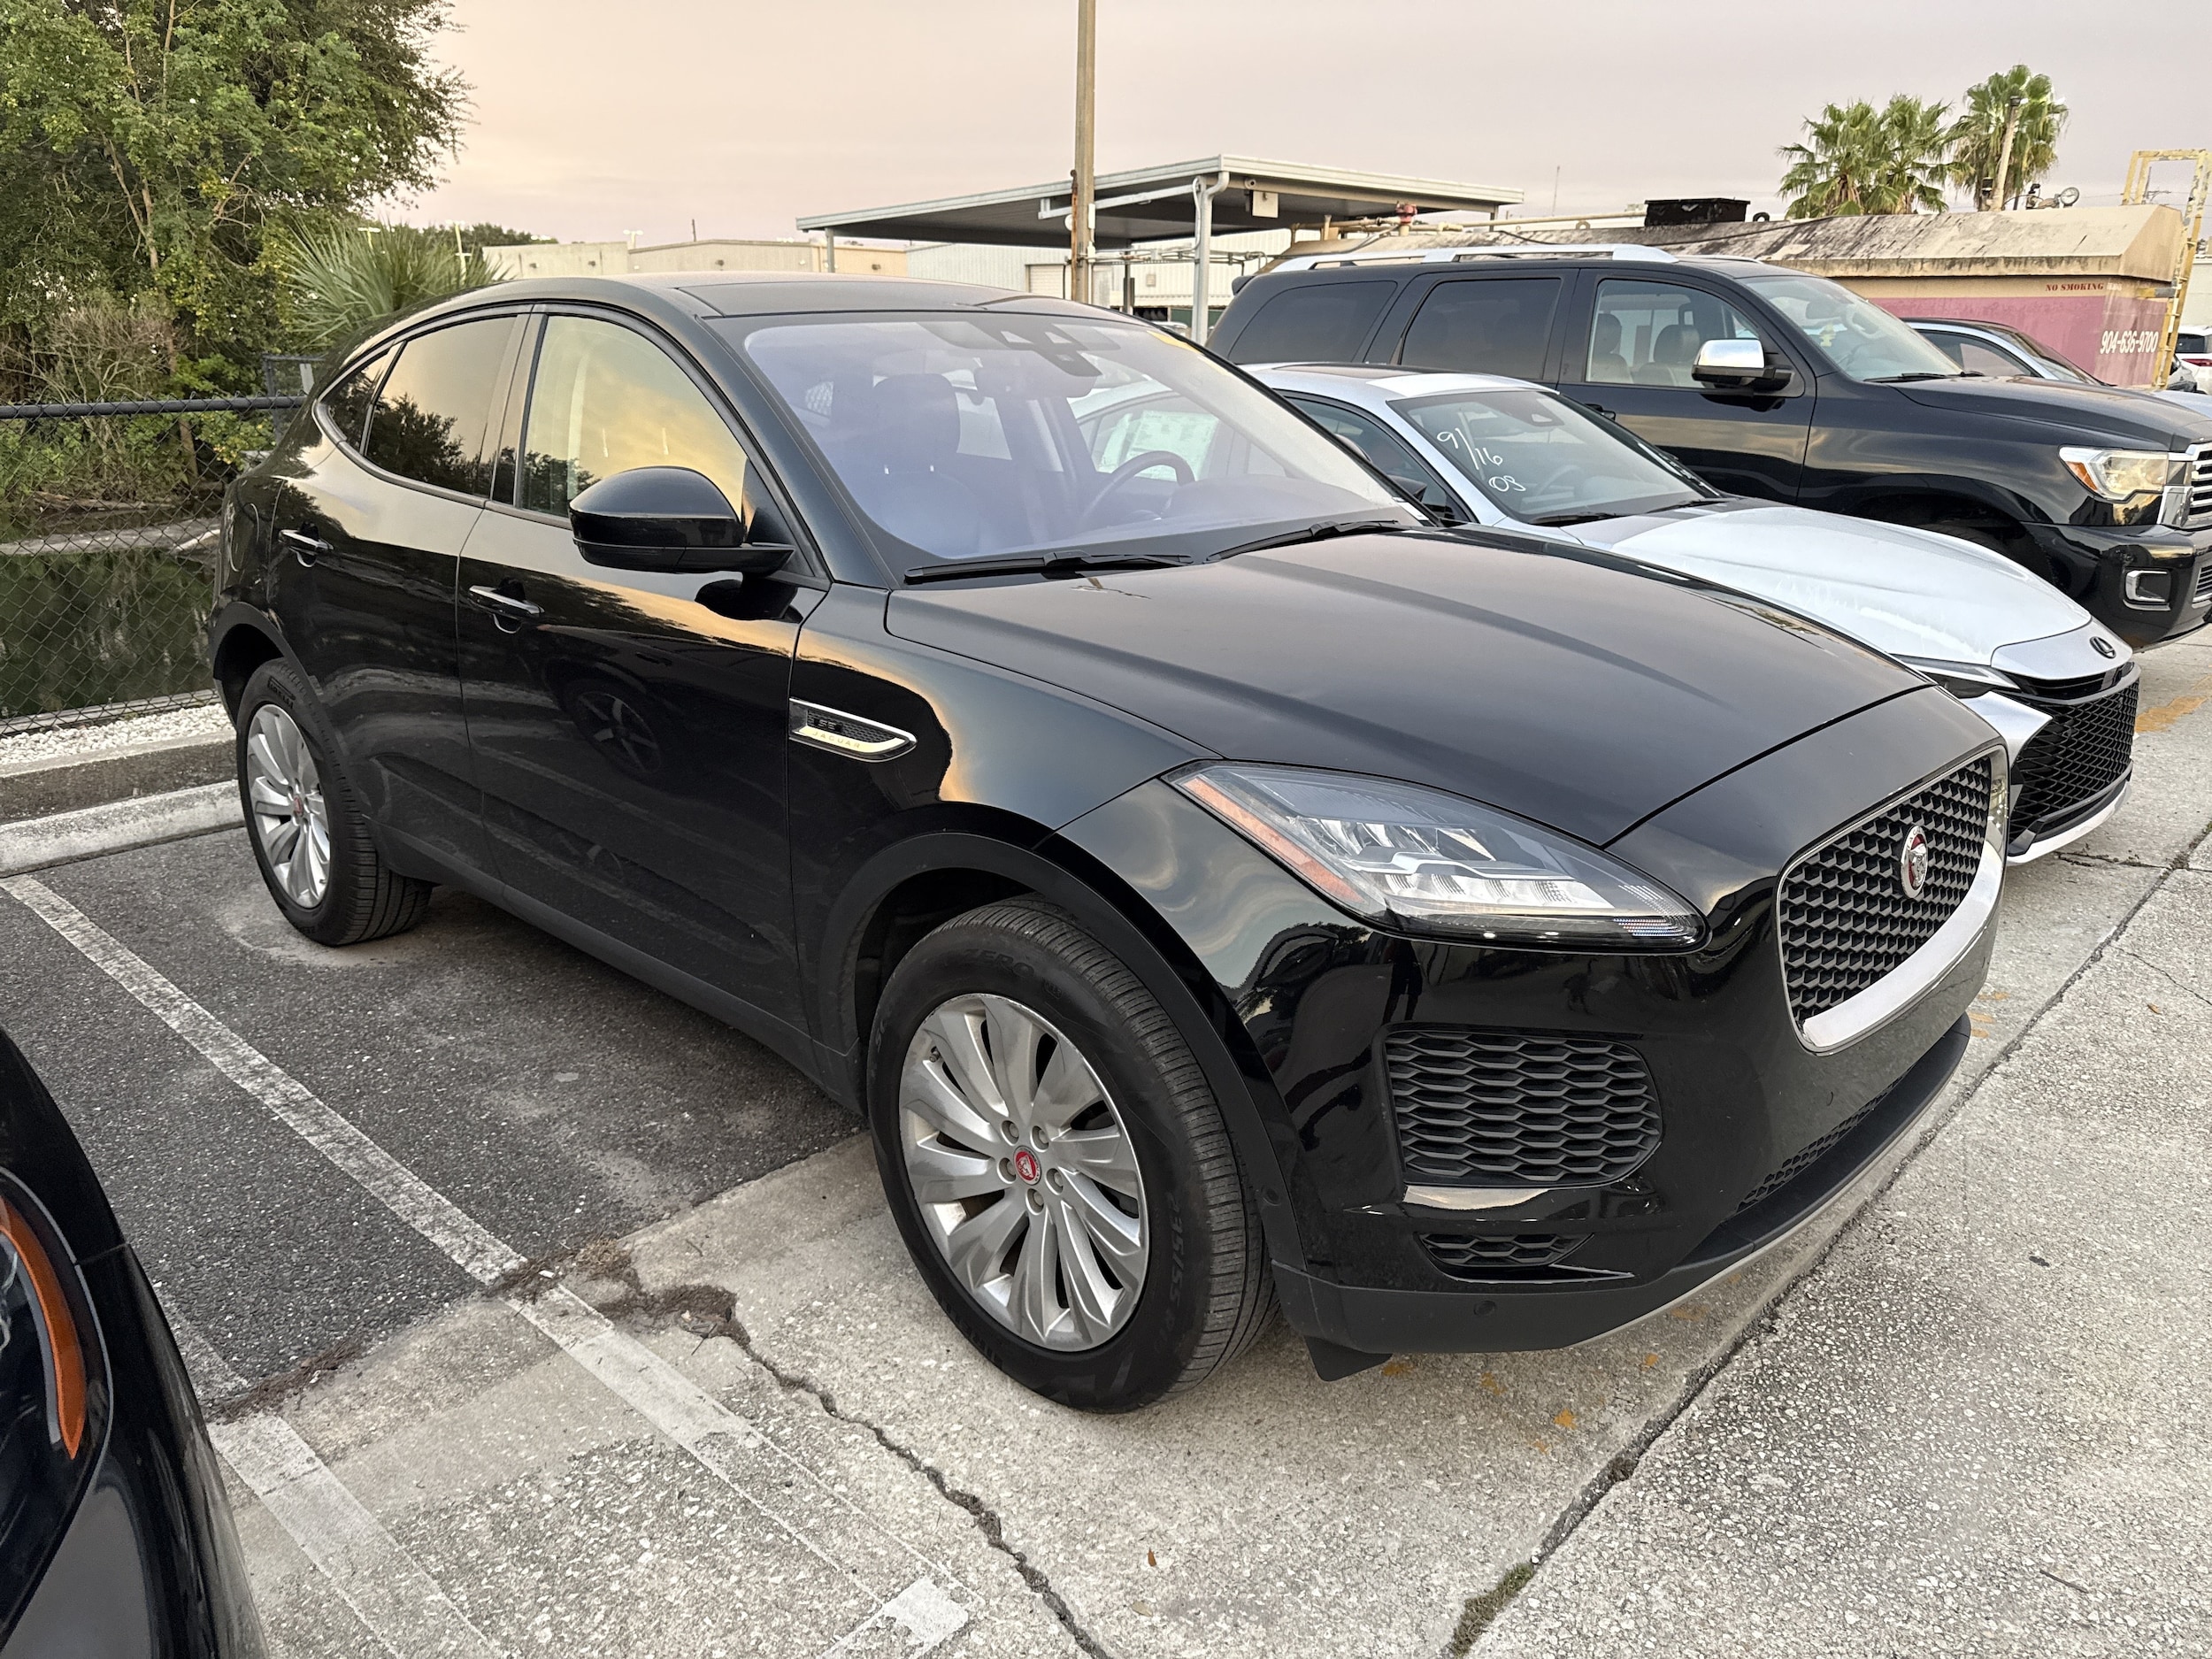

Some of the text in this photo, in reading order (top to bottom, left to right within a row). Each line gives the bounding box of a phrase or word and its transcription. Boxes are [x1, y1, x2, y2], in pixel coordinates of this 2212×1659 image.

[2100, 330, 2159, 354] 904-636-9700
[1436, 427, 1503, 470] 9/16
[812, 731, 861, 749] JAGUAR
